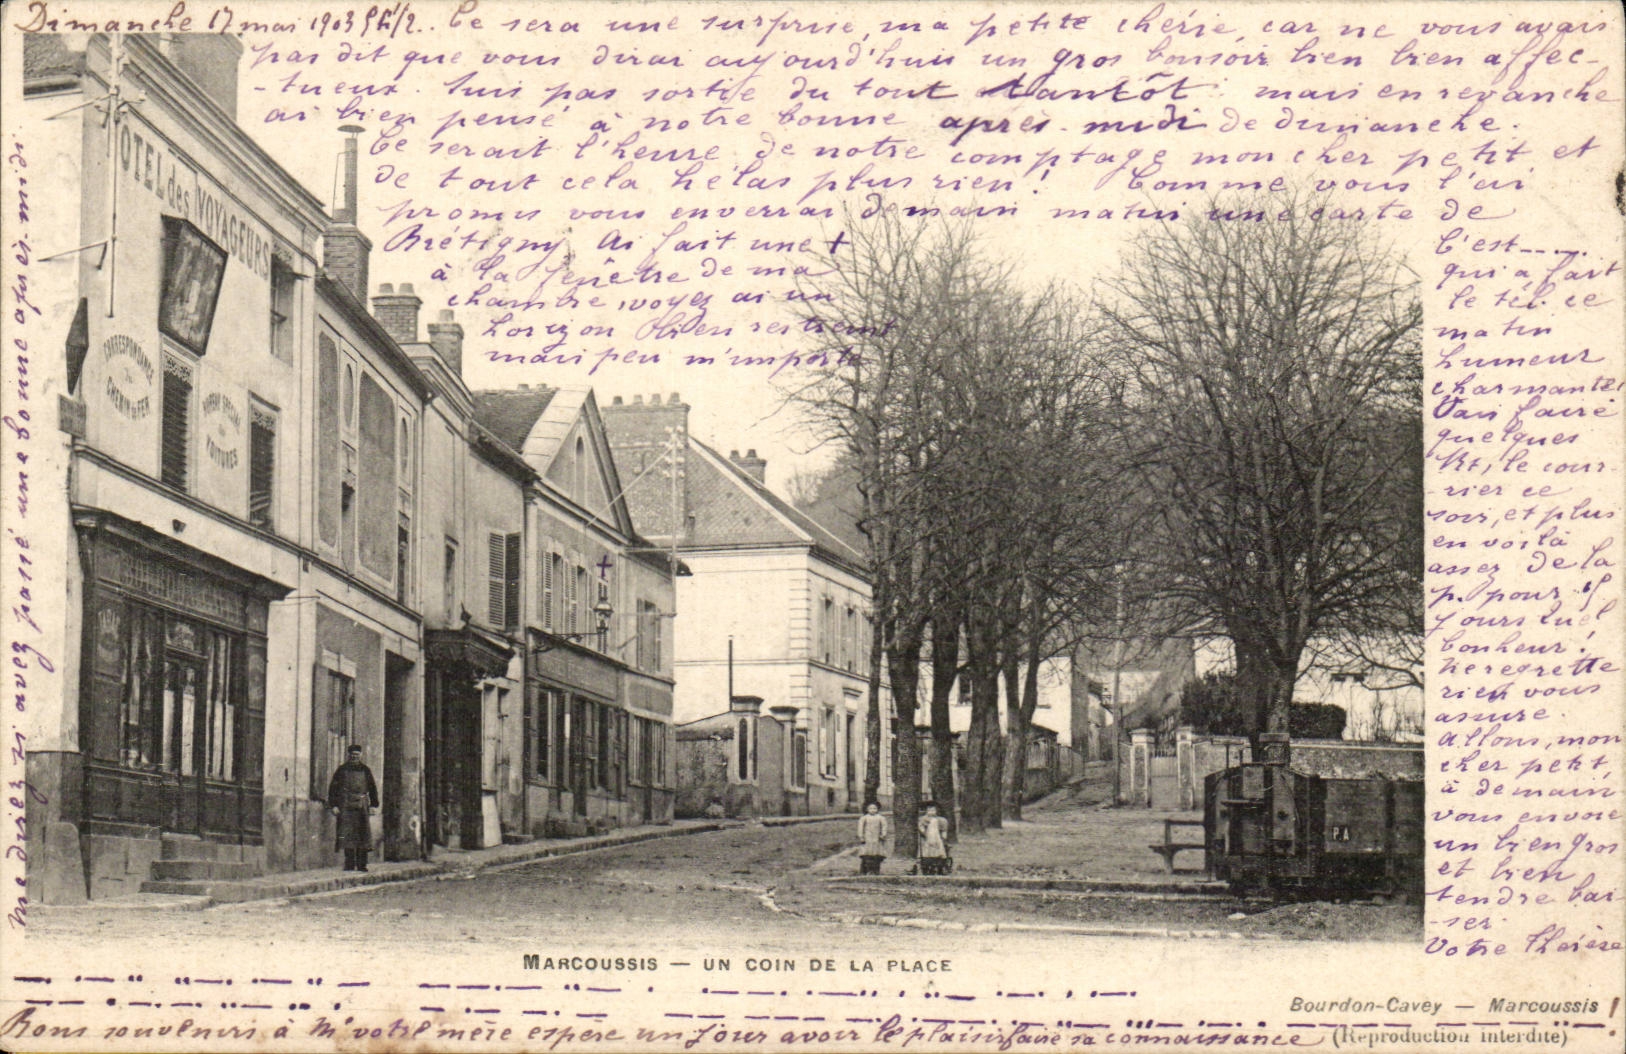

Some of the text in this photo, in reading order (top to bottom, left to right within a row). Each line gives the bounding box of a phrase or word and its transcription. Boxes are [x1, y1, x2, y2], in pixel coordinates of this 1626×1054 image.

[15, 2, 194, 34] Dimanche
[209, 8, 233, 37] 17
[241, 22, 296, 33] mai
[310, 11, 354, 38] 1903
[449, 8, 483, 29] Ce
[501, 19, 579, 33] sera
[606, 17, 678, 33] une
[880, 21, 949, 33] ma
[964, 13, 1091, 46] petite
[1262, 20, 1317, 34] car
[1340, 25, 1392, 38] ne
[1421, 22, 1502, 36] vous
[1515, 22, 1606, 38] avais
[251, 42, 316, 69] pas
[337, 42, 390, 63] dit
[402, 51, 462, 77] que
[482, 52, 560, 66] vous
[592, 44, 684, 67] dirai
[981, 54, 1027, 67] un
[1048, 48, 1123, 85] gros
[1146, 35, 1269, 66] bonsoir
[1289, 42, 1362, 67] bien
[1393, 42, 1464, 66] bien
[543, 82, 617, 112] pas
[642, 74, 759, 104] sortie
[789, 76, 829, 101] du
[853, 77, 959, 101] tout
[1255, 86, 1359, 101] mais
[1377, 84, 1422, 101] en
[264, 106, 318, 123] ai
[336, 102, 416, 128] bien
[434, 111, 555, 135] pensé
[589, 113, 622, 134] à
[644, 106, 751, 132] notre
[778, 101, 904, 127] bonne
[1219, 107, 1257, 133] de
[429, 136, 552, 159] serait
[575, 130, 720, 162] l'heure
[755, 132, 796, 162] de
[814, 136, 925, 159] notre
[1191, 151, 1274, 166] mon
[1293, 132, 1374, 166] cher
[1553, 136, 1600, 160] et
[374, 164, 409, 189] de
[439, 166, 540, 192] tout
[562, 164, 638, 190] cela
[798, 162, 913, 206] plus
[1316, 179, 1410, 192] vous
[167, 164, 190, 219] des
[196, 185, 270, 281] VOYAGEURS
[569, 208, 645, 220] vous
[670, 205, 834, 220] enverrai
[1204, 208, 1296, 223] une
[1309, 200, 1413, 224] carte
[1440, 198, 1516, 221] de
[635, 225, 737, 272] fait
[750, 238, 812, 253] une
[430, 257, 840, 282] à de ma
[1436, 252, 1623, 298] qui a fait
[784, 290, 835, 304] un
[1448, 284, 1614, 310] le ce
[1433, 315, 1552, 341] matin
[484, 346, 583, 365] mais
[594, 347, 660, 373] peu
[1435, 342, 1605, 369] humeur
[3, 338, 31, 440] bonne
[1503, 393, 1618, 434] faire
[1426, 420, 1580, 461] quelques
[1502, 448, 1530, 472] le
[16, 452, 29, 519] une
[1522, 484, 1573, 498] ce
[1504, 498, 1615, 531] et plus
[1433, 526, 1569, 550] en voilà
[1527, 538, 1615, 573] de la
[8, 529, 43, 634] passé
[1475, 586, 1562, 613] pour
[11, 642, 56, 712] avez
[1524, 684, 1601, 698] vous
[1557, 735, 1622, 747] mon
[1440, 749, 1507, 772] cher
[1440, 778, 1616, 798] à demain
[1433, 809, 1503, 823] vous
[1434, 840, 1479, 852] un
[1494, 824, 1561, 853] bien
[1438, 858, 1472, 878] et
[8, 878, 28, 927] me
[1425, 884, 1550, 906] tendre
[273, 1018, 294, 1039] à
[637, 1028, 683, 1042] un
[780, 1030, 860, 1043] avoir
[1106, 1024, 1324, 1046] connaissance
